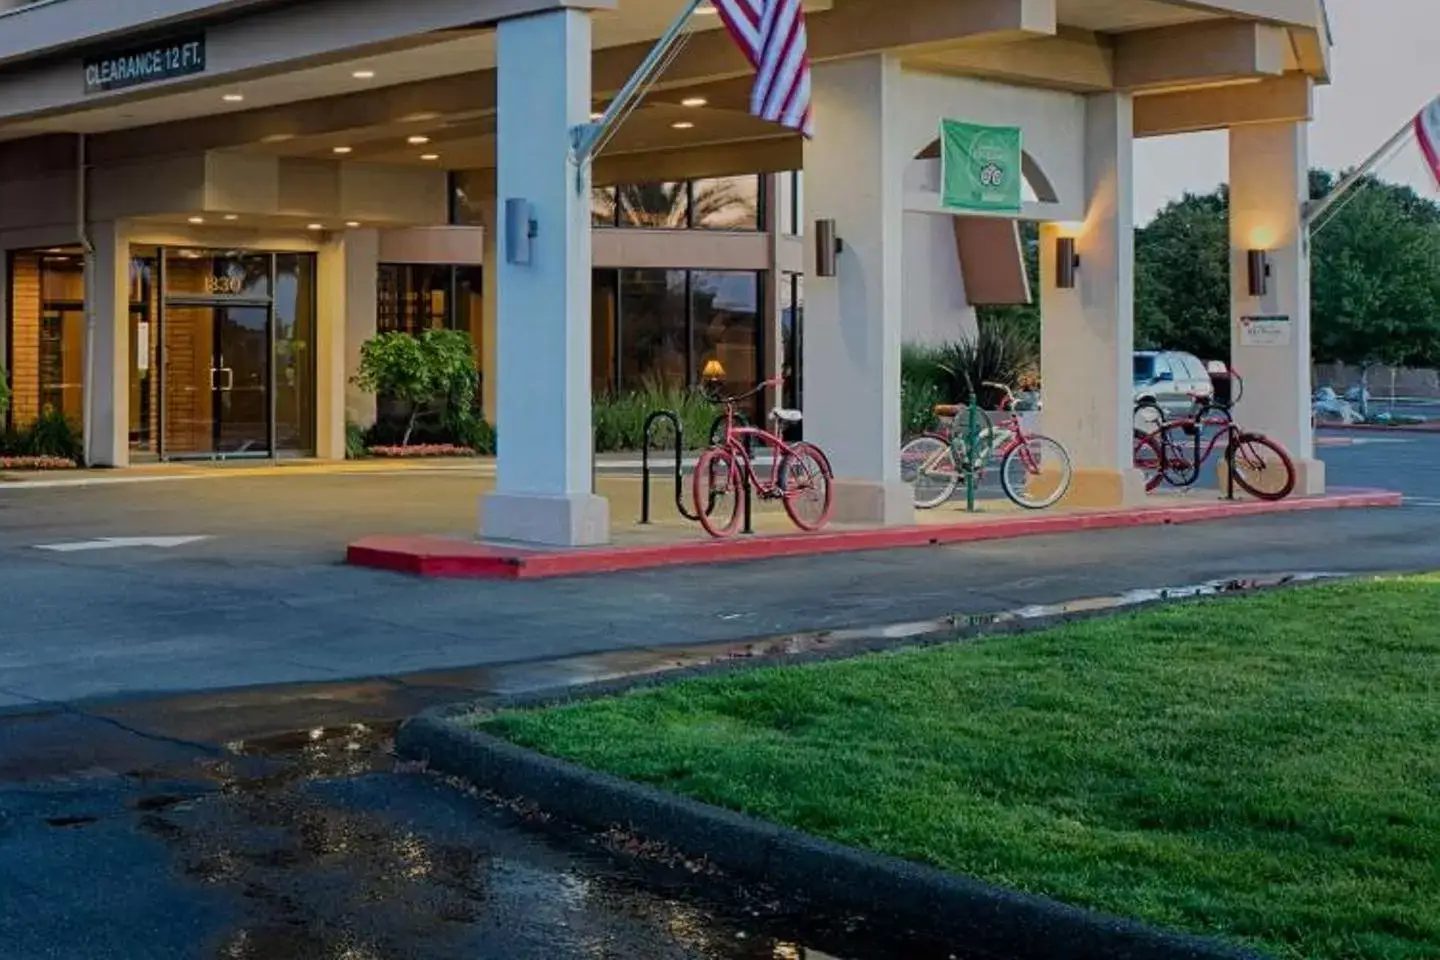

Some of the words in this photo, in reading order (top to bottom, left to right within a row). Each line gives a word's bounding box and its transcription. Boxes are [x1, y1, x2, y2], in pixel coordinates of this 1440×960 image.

[86, 50, 161, 85] CLEARANCE
[165, 46, 180, 70] 12
[182, 41, 201, 66] FT.
